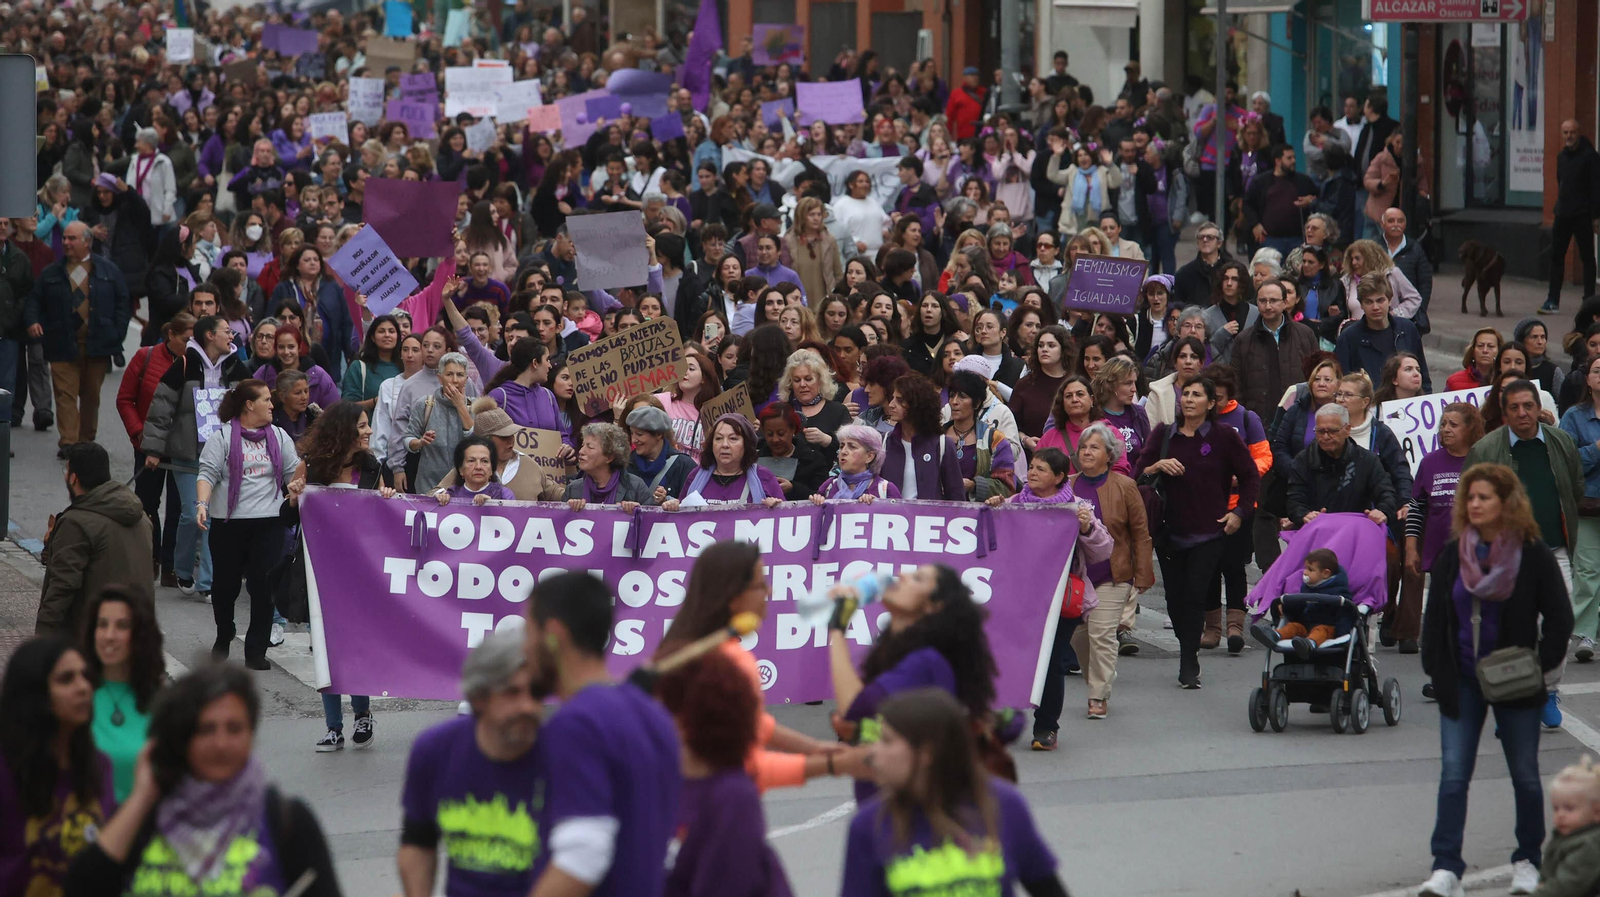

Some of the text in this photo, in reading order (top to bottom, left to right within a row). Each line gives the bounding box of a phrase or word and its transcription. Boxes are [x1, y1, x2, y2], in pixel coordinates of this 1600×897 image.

[350, 250, 379, 277] ENSEÑARON
[352, 248, 364, 259] NOS
[1074, 258, 1141, 277] FEMINISMO
[361, 274, 370, 284] SER
[364, 265, 399, 298] DECIDIMOS SER
[380, 280, 401, 301] ALIADAS
[1072, 289, 1131, 305] IGUALDAD
[568, 320, 667, 365] SOMOS LAS NIETAS
[575, 331, 675, 382] DE LAS BRUJAS
[576, 346, 682, 394] QUE NO PUDISTE
[606, 365, 678, 403] QUEMAR
[243, 466, 266, 475] OVE
[405, 510, 978, 558] TODAS LAS MUJERES
[383, 557, 569, 603] TODO
